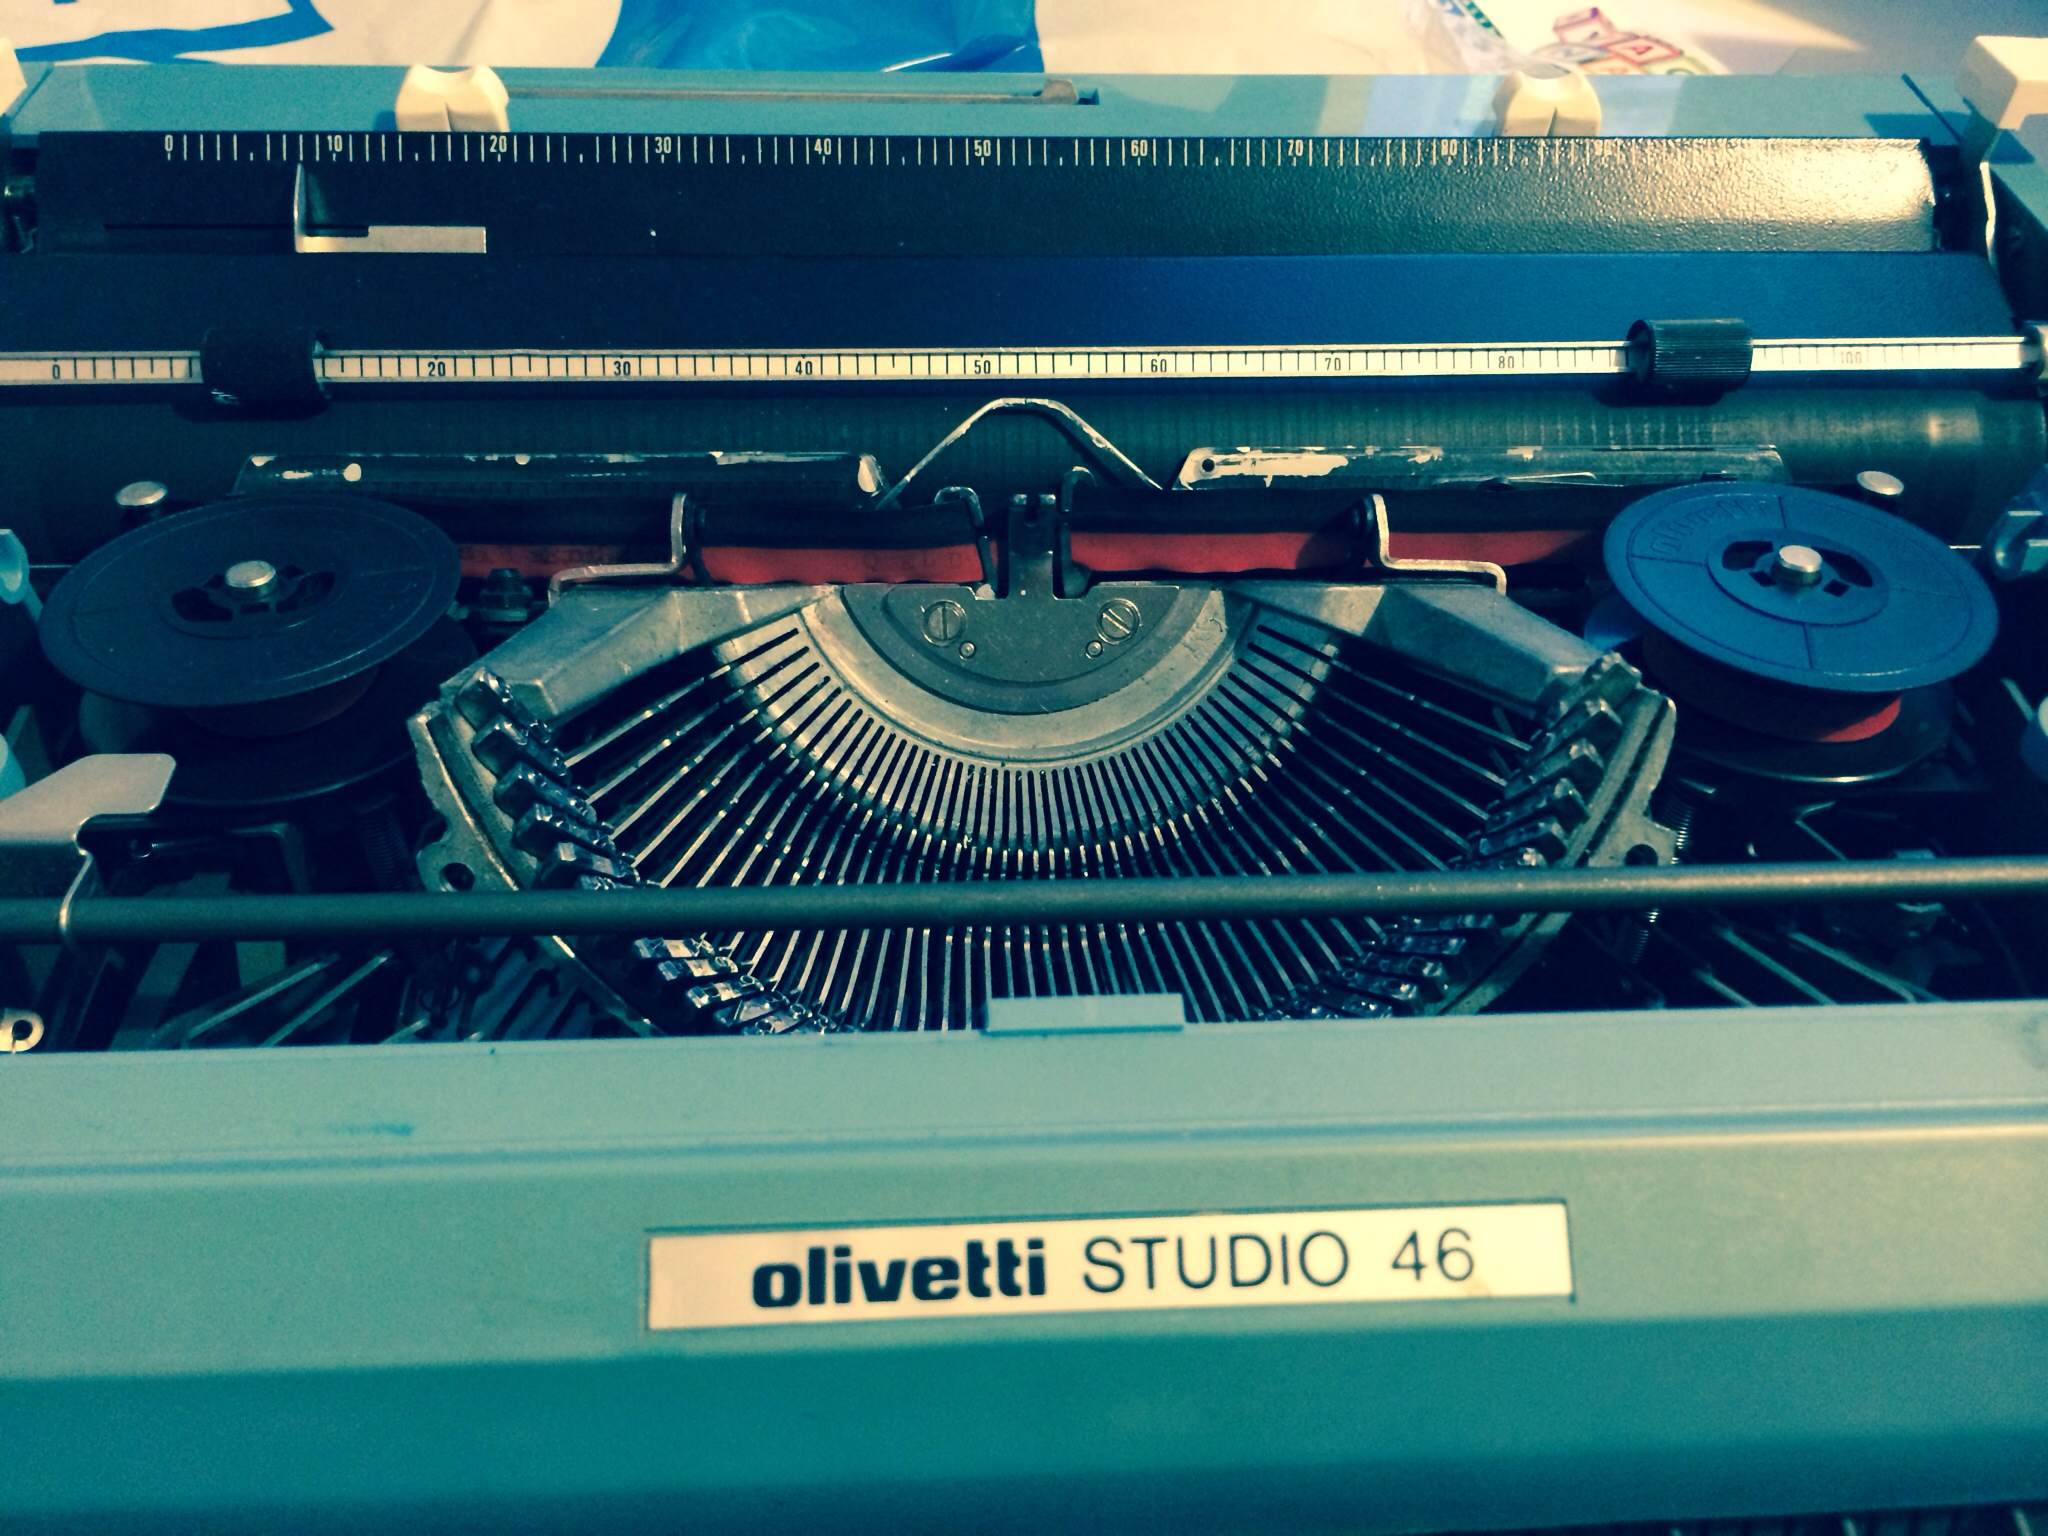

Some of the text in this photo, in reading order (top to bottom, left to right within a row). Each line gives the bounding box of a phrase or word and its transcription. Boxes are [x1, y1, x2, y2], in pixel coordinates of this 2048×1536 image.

[164, 134, 174, 152] 0
[327, 135, 343, 153] 10
[489, 135, 507, 153] 20
[654, 136, 672, 154] 30
[813, 138, 832, 156] 40
[973, 139, 991, 157] 50
[1130, 140, 1148, 157] 60
[1287, 139, 1304, 157] 70
[51, 364, 61, 380] 0
[427, 361, 446, 377] 20
[613, 360, 631, 376] 30
[795, 360, 813, 376] 40
[973, 359, 992, 375] 50
[1150, 358, 1168, 373] 60
[1324, 357, 1341, 371] 70
[1498, 356, 1515, 369] 80
[753, 1227, 1474, 1308] olivetti STUDIO 46
